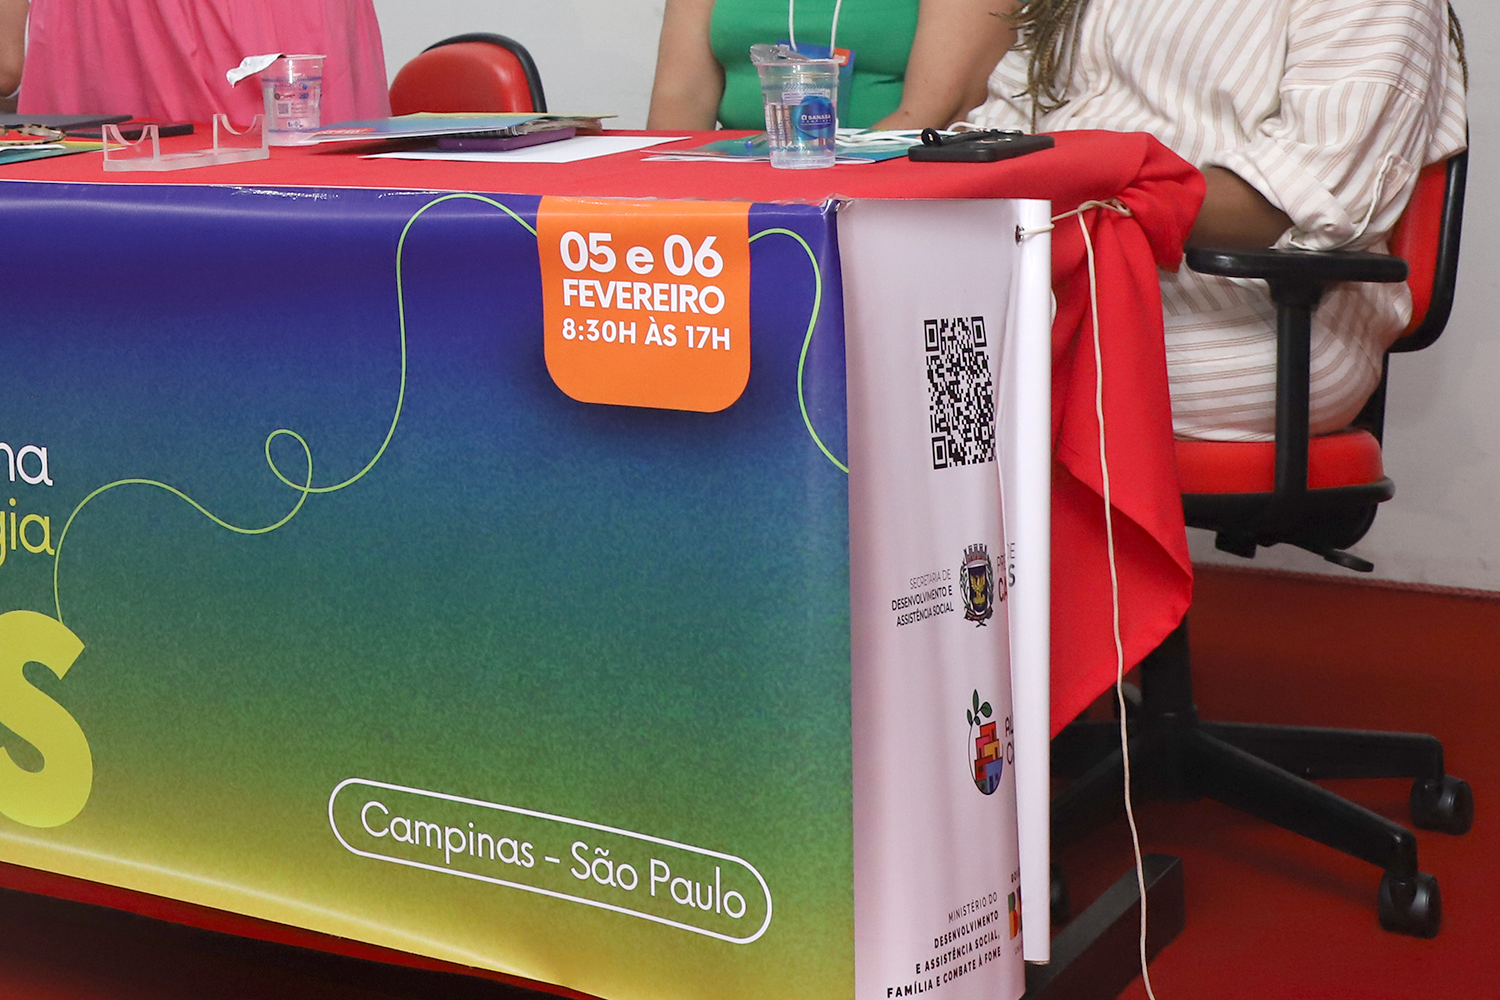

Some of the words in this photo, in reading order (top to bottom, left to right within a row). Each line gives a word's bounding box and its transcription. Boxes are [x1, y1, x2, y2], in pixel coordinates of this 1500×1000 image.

[559, 230, 617, 273] 05
[626, 246, 654, 275] e
[663, 234, 724, 278] 06
[562, 278, 726, 315] FEVEREIRO
[562, 318, 637, 344] 8:30H
[644, 316, 678, 347] ÀS
[685, 325, 731, 351] 17H
[909, 572, 941, 590] SECRETARIA
[942, 569, 952, 582] DE
[891, 586, 947, 611] DESENVOLVIMENTO
[948, 585, 953, 597] E
[896, 608, 933, 627] ASSISTÊNCIA
[932, 602, 954, 617] SOCIAL
[360, 800, 535, 868] Campinas
[571, 841, 638, 891] São
[650, 858, 747, 919] Paulo
[948, 897, 987, 924] MINISTÉRIO
[988, 892, 998, 905] DO
[934, 910, 999, 949] DESENVOLVIMENTO
[887, 979, 933, 999] FAMÍLIA
[936, 976, 941, 987] E
[943, 960, 976, 984] COMBATE
[978, 954, 983, 967] À
[985, 946, 1001, 965] FOME
[916, 963, 921, 975] E
[924, 942, 973, 972] ASSISTÊNCIA
